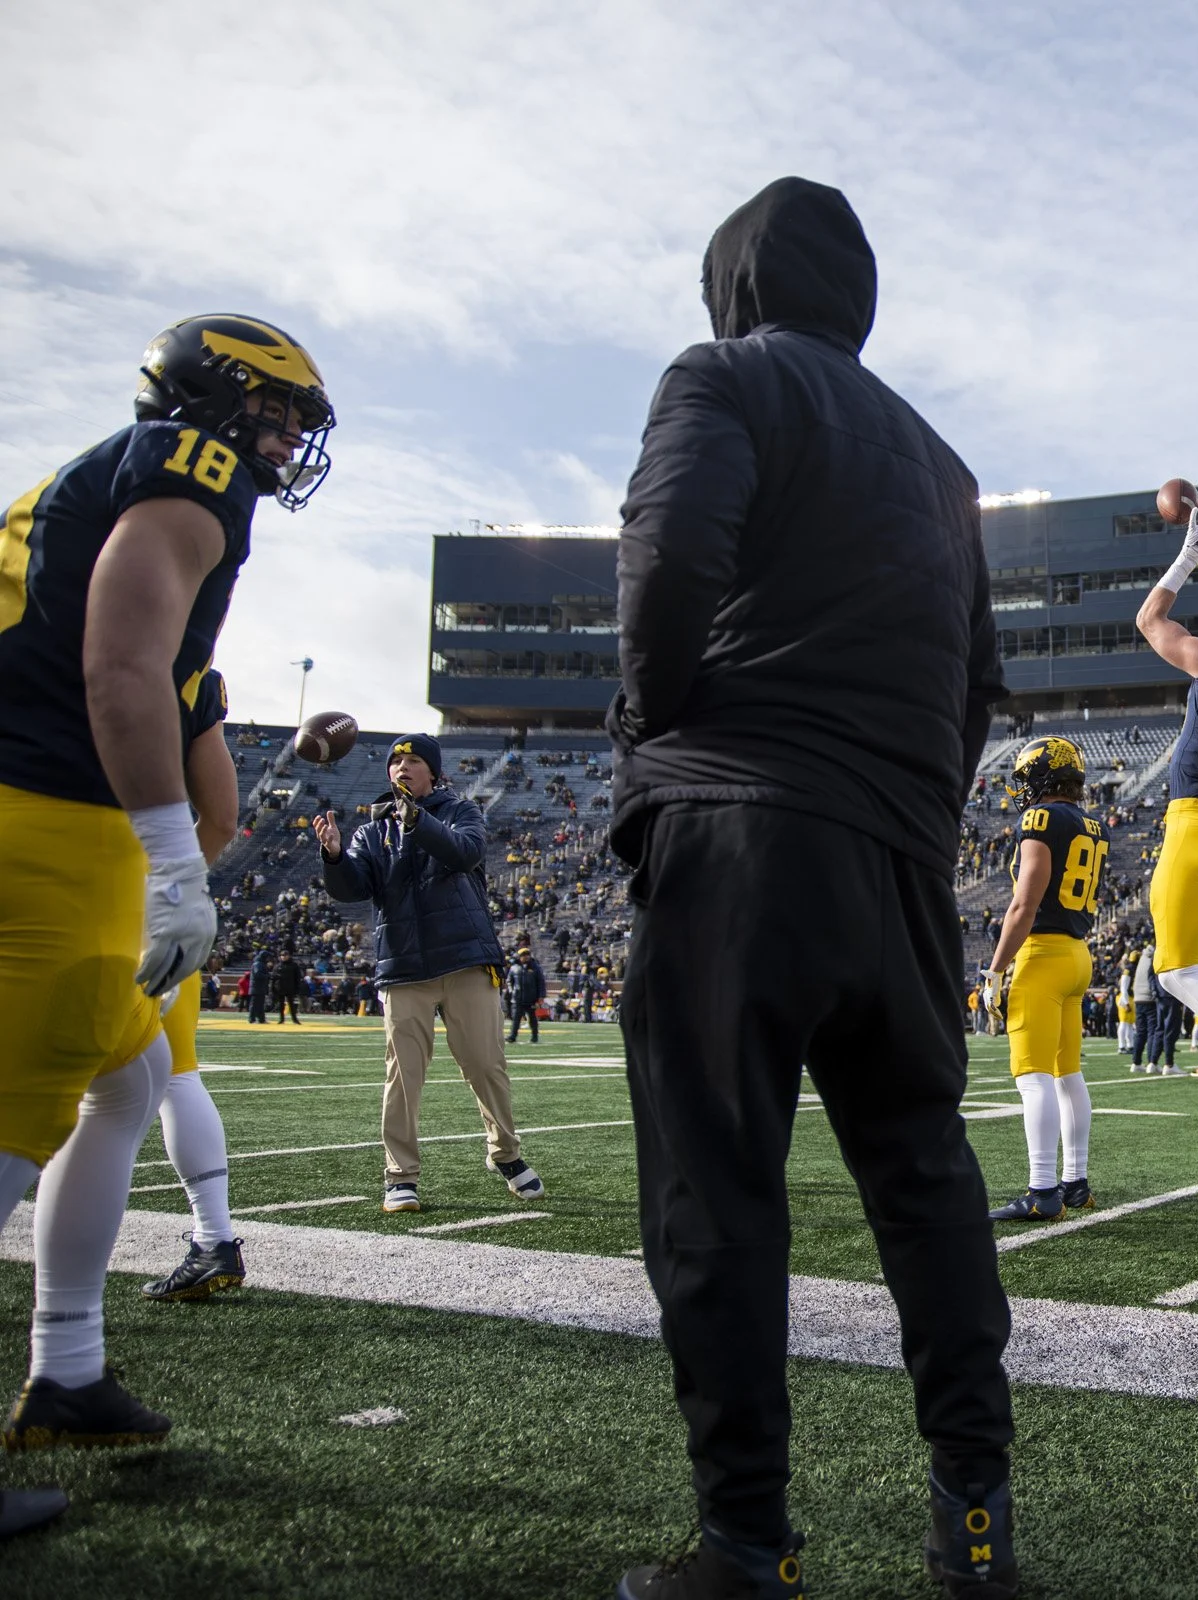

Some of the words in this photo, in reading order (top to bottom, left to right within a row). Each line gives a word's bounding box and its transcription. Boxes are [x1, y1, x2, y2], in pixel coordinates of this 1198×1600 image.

[163, 428, 239, 493] 18
[394, 742, 412, 754] M
[1021, 808, 1050, 831] 80
[970, 1544, 993, 1562] M
